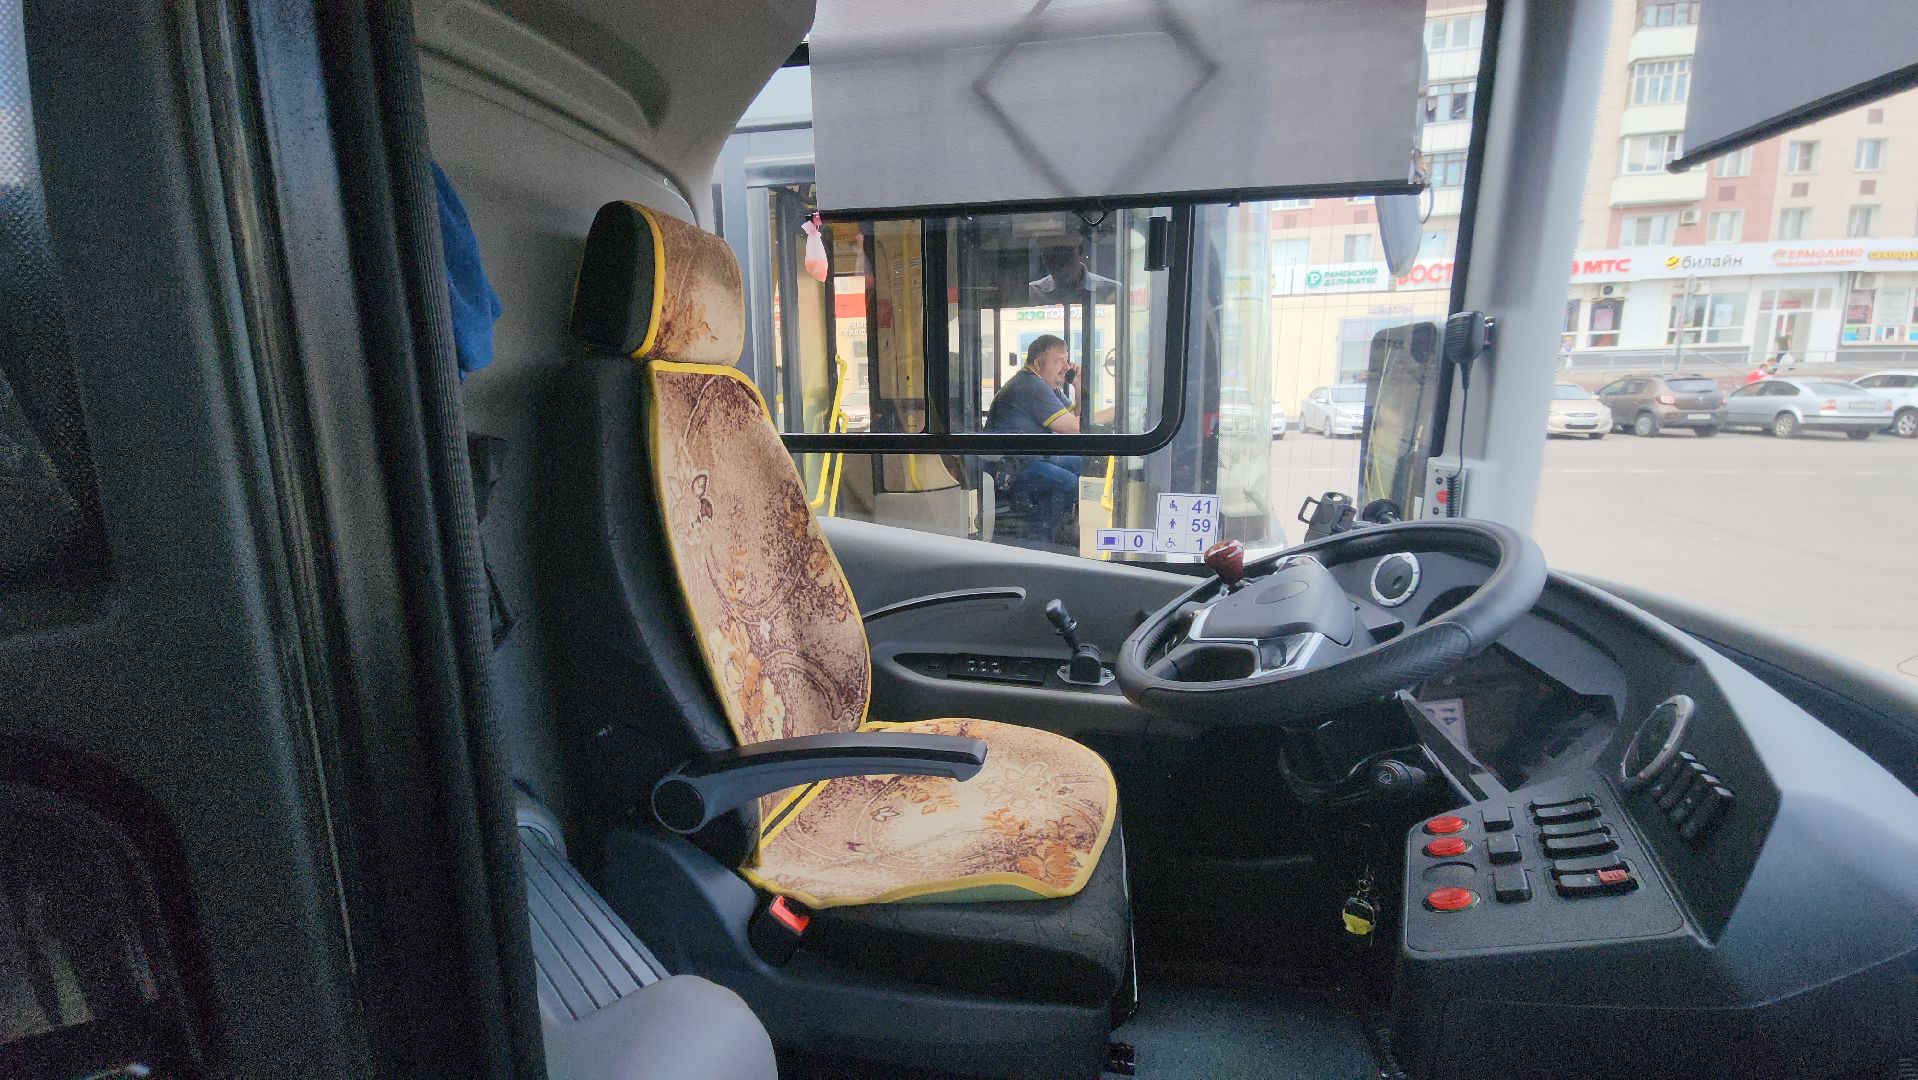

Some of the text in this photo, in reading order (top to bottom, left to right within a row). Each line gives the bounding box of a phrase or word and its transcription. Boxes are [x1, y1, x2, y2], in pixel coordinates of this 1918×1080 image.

[1583, 258, 1632, 274] МТС
[1682, 254, 1742, 269] билайн
[1191, 500, 1211, 514] 41
[1191, 519, 1211, 533] 59
[1133, 534, 1144, 548] 0
[1195, 537, 1204, 551] 1
